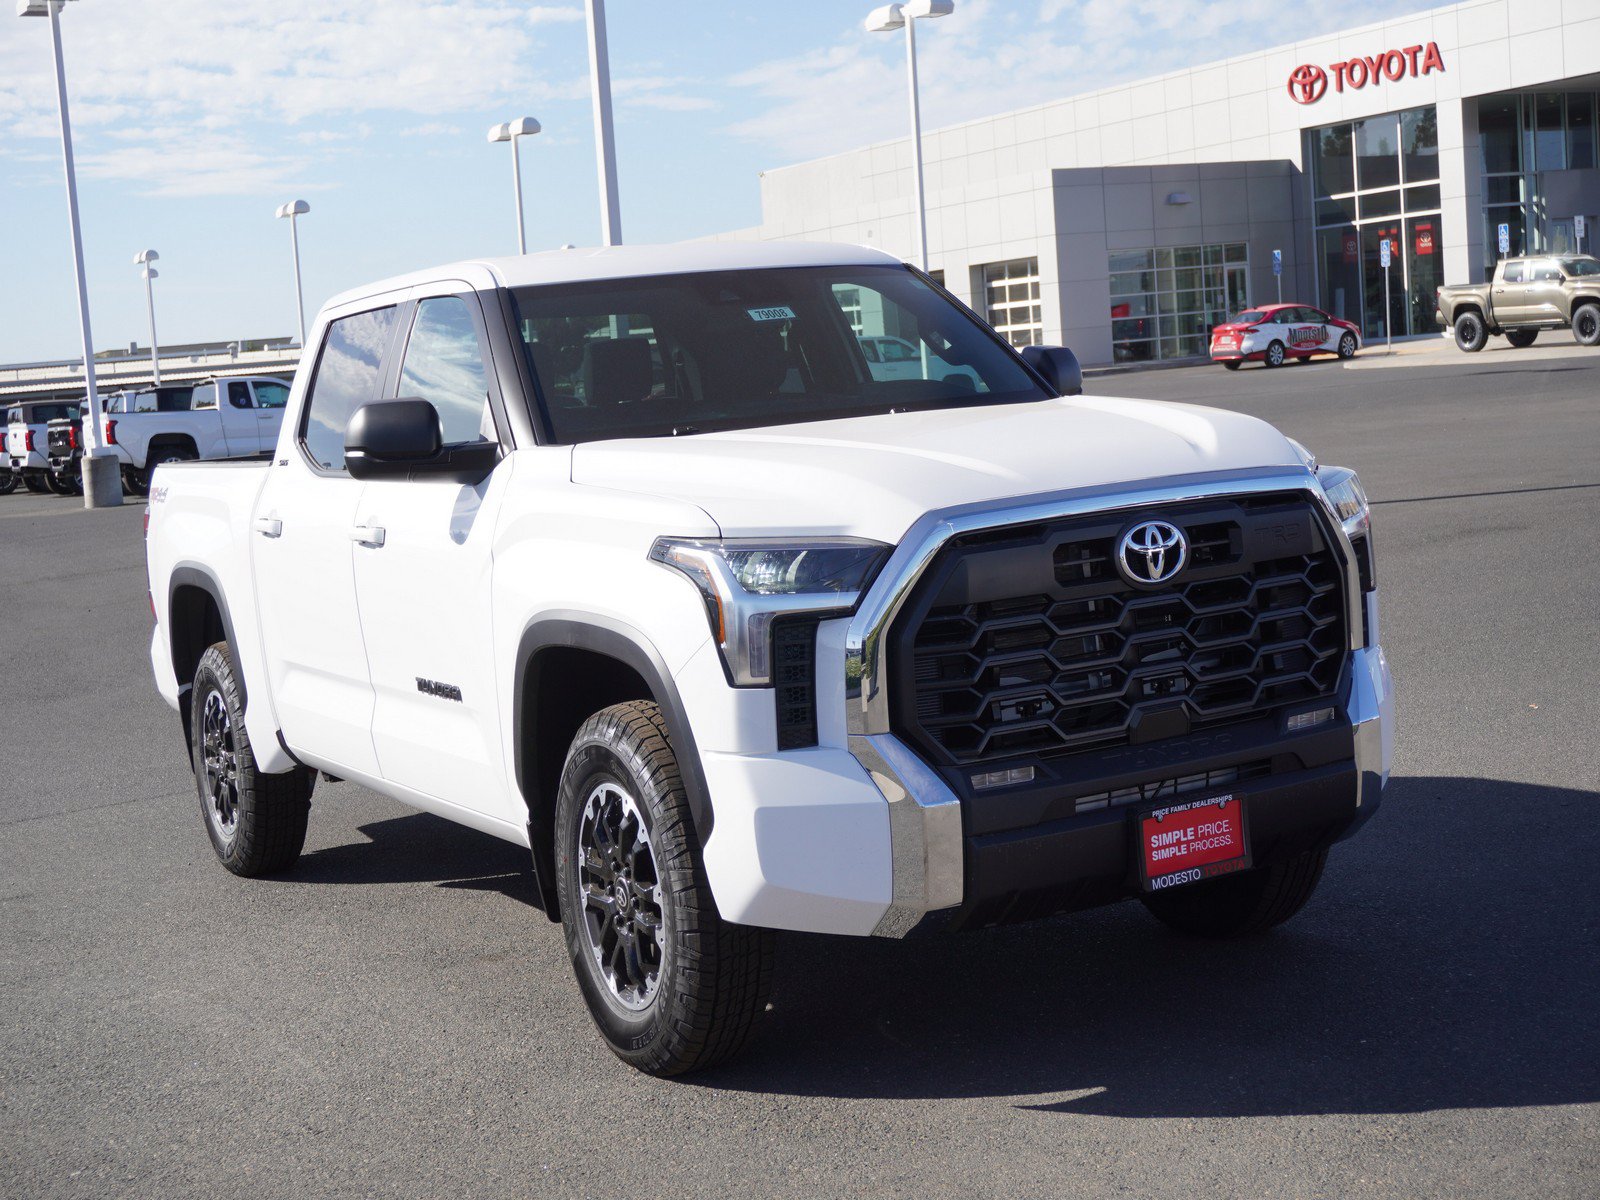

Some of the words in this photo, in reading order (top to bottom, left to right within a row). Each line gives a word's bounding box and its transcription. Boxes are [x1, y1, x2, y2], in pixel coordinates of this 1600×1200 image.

[1329, 41, 1446, 93] TOYOTA
[755, 308, 788, 319] 79008
[1288, 324, 1328, 344] MODESTO
[415, 676, 463, 704] TUNDRA
[1151, 807, 1169, 818] PRICE
[1170, 803, 1192, 815] FAMILY
[1192, 794, 1233, 809] DEALERSHIPS
[1150, 827, 1195, 848] SIMPLE
[1197, 819, 1233, 838] PRICE.
[1151, 844, 1188, 861] SIMPLE
[1189, 834, 1234, 853] PROCESS.
[1151, 868, 1201, 890] MODESTO
[1204, 859, 1245, 878] TOYOTA
